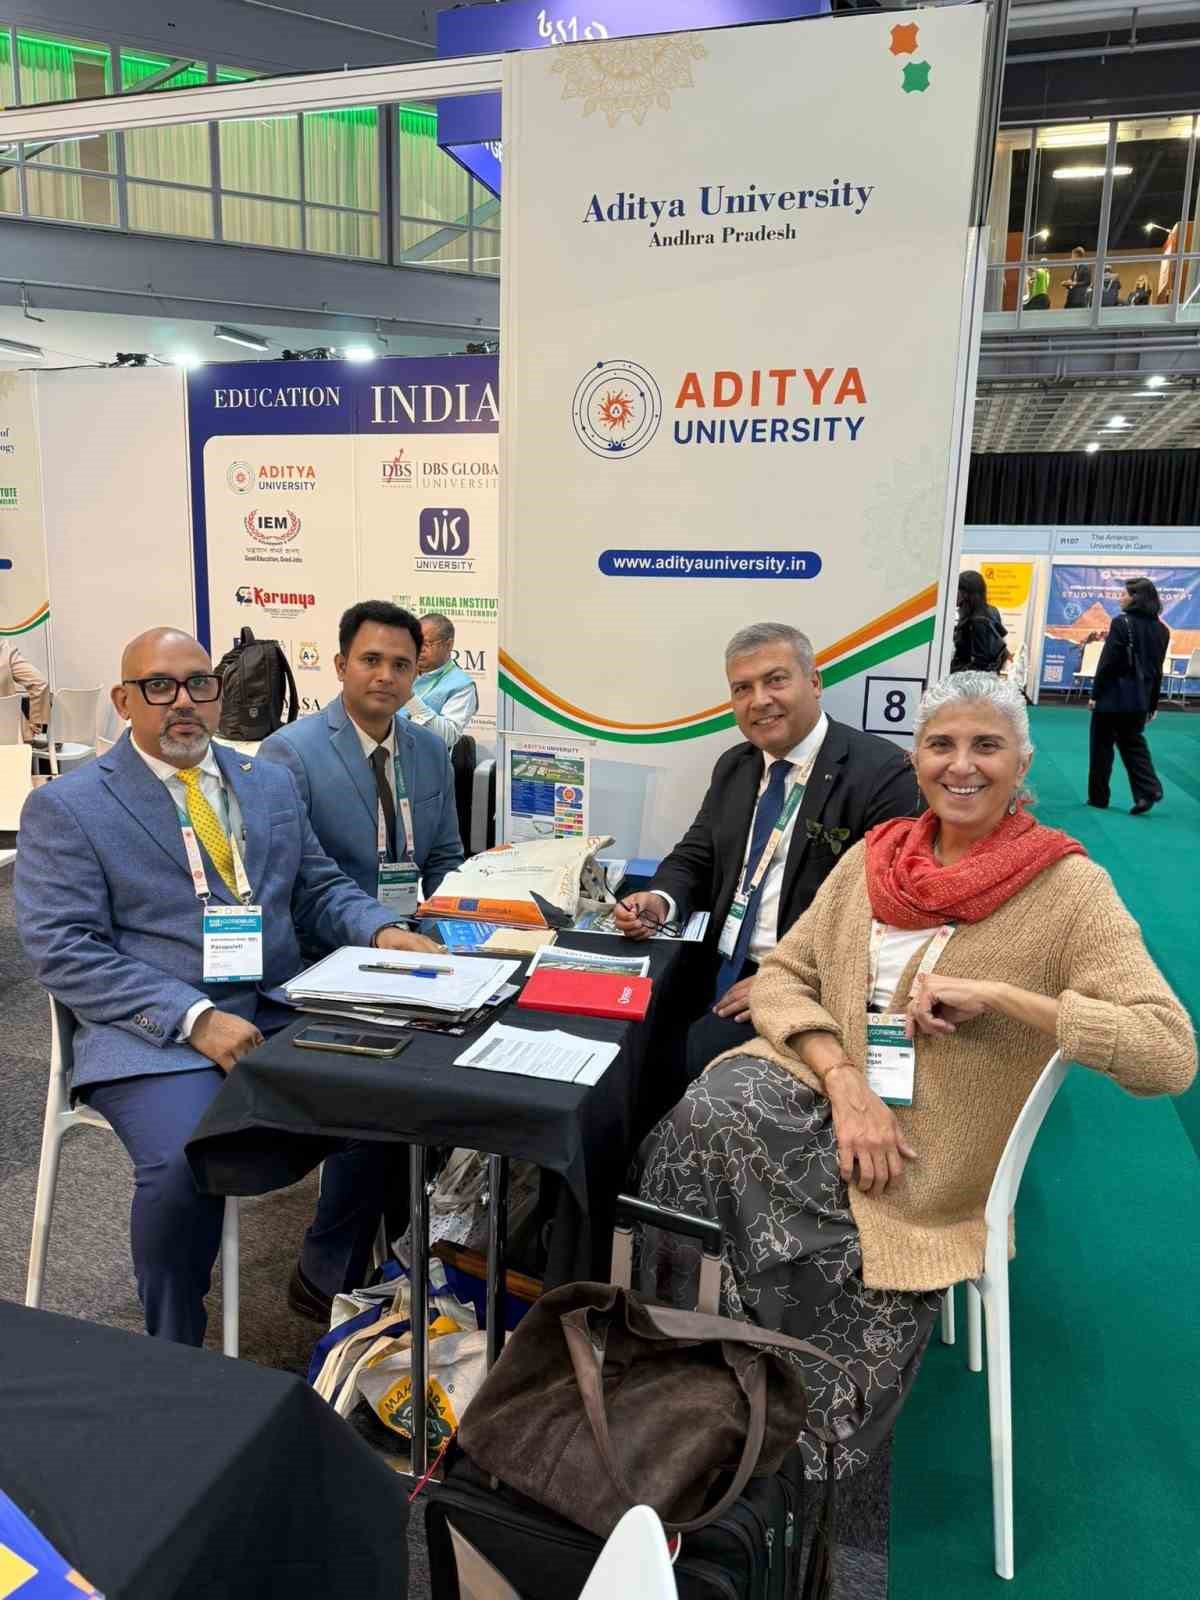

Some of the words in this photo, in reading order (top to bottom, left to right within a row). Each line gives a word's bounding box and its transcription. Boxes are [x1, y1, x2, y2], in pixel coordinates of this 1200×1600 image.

[582, 192, 686, 227] Aditya
[699, 178, 875, 215] University
[648, 229, 715, 248] Andhra
[721, 223, 797, 244] Pradesh
[213, 386, 341, 409] EDUCATION
[674, 367, 868, 409] ADITYA
[370, 382, 499, 424] INDIA
[673, 416, 866, 444] UNIVERSITY
[258, 465, 316, 479] ADITYA
[382, 463, 413, 478] DBS
[423, 462, 449, 476] DBS
[258, 481, 316, 491] UNIVERSITY
[257, 516, 288, 529] IEM
[416, 560, 473, 570] UNIVERSITY
[612, 554, 807, 575] www.adityauniversity.in
[253, 586, 316, 609] Karunya
[419, 596, 457, 608] KALINGA
[884, 690, 906, 723] 8
